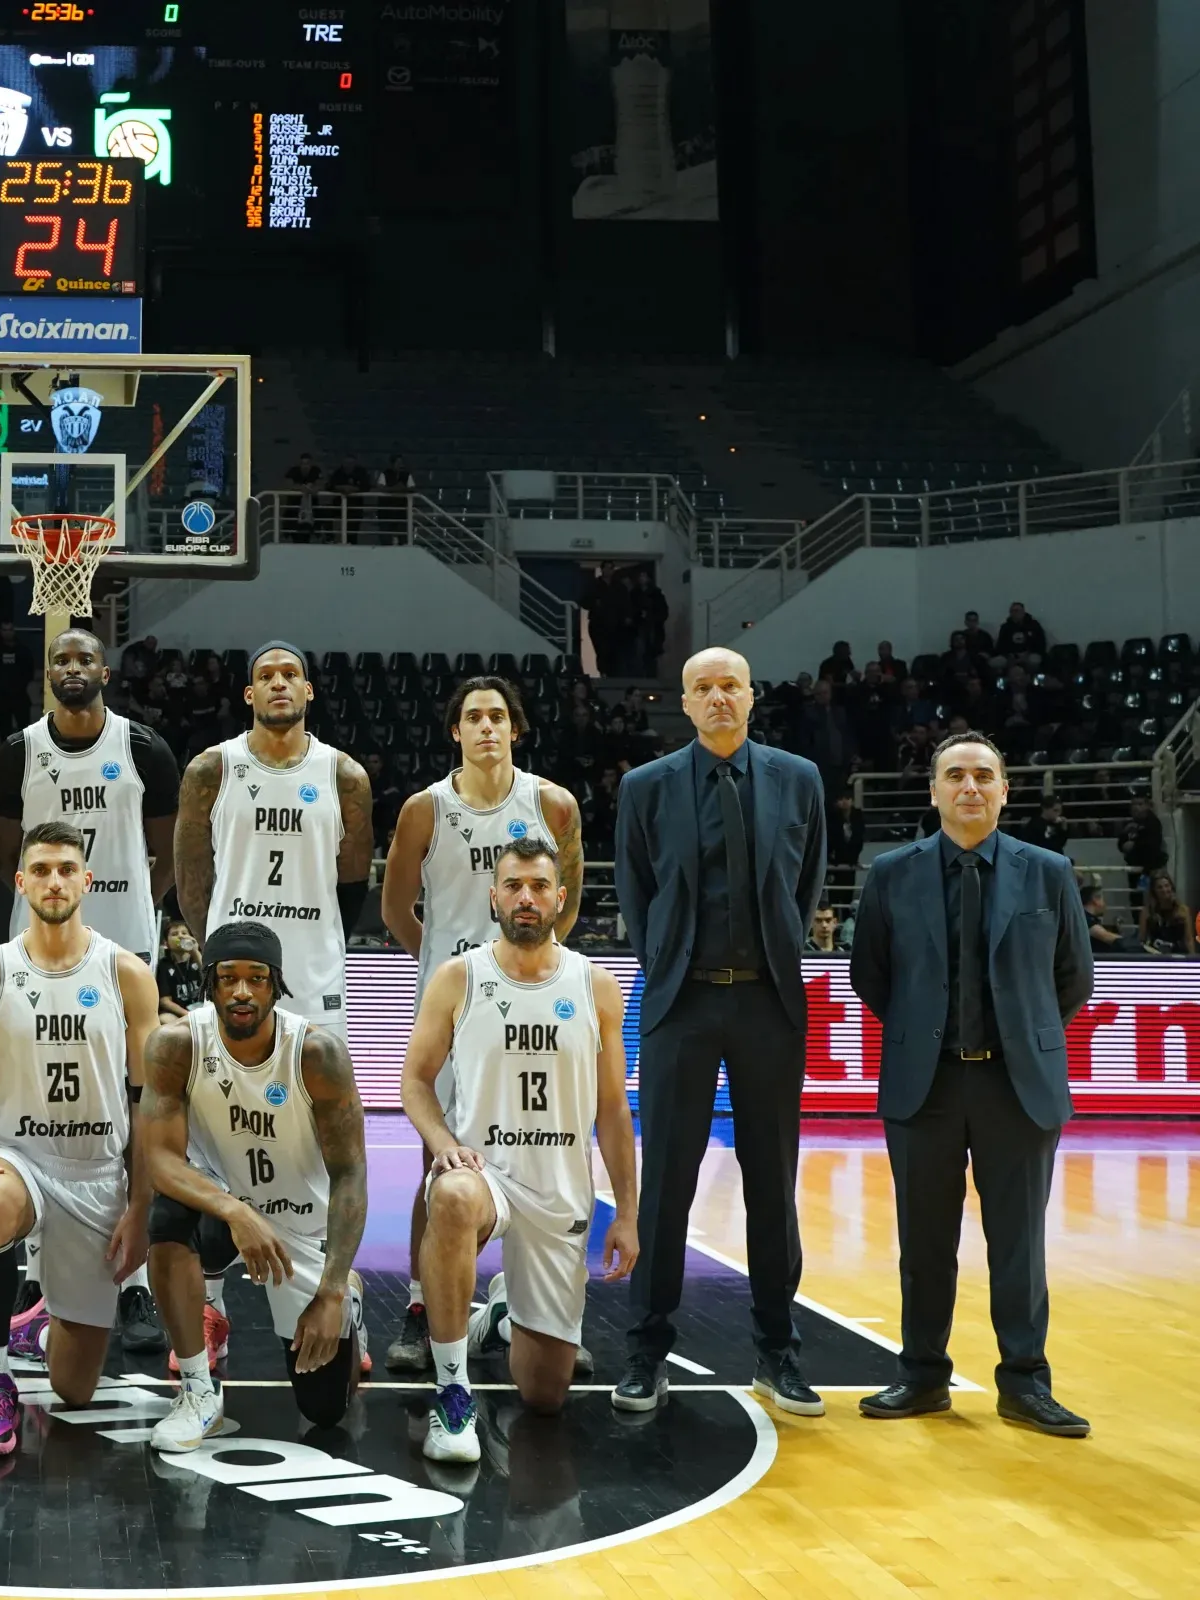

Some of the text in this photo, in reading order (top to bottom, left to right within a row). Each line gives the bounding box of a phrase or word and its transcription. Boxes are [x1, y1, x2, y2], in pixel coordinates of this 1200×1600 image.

[30, 2, 84, 22] 25:36
[164, 4, 180, 23] 0
[299, 8, 345, 20] GUEST
[380, 5, 504, 25] AutoMobility
[145, 28, 182, 38] SCORE
[302, 24, 344, 42] TRE
[208, 59, 266, 69] TIME-OUTS
[282, 60, 351, 70] TEAM FOULS
[339, 72, 353, 89] 0
[318, 102, 362, 112] ROSTER
[254, 113, 304, 124] 0 GASHI
[41, 127, 73, 147] VS
[269, 124, 311, 135] RUSSEL
[317, 125, 333, 135] JR
[269, 134, 305, 145] PAYNE
[269, 145, 340, 156] ARSLANAGIC
[270, 155, 298, 165] TUNA
[0, 161, 132, 204] 25:36
[269, 186, 318, 197] HAJRIZI
[269, 197, 305, 207] JONES
[269, 207, 305, 217] BROWN
[269, 217, 311, 228] KAPITI
[14, 215, 118, 277] 24
[56, 278, 111, 293] Quince
[185, 536, 210, 544] FIBA
[340, 566, 355, 576] 115
[61, 786, 107, 812] PAOK
[255, 807, 303, 832] PAOK
[78, 829, 96, 863] 7
[470, 846, 503, 871] PA
[267, 851, 284, 886] 2
[229, 898, 321, 921] Stoiximan
[35, 1014, 87, 1041] PAOK
[505, 1024, 559, 1051] PAOK
[46, 1062, 80, 1103] 25
[517, 1072, 547, 1112] 13
[14, 1115, 114, 1138] Stoiximan
[229, 1104, 277, 1139] PAOK
[245, 1148, 275, 1187] 16
[358, 1530, 431, 1554] 21+
